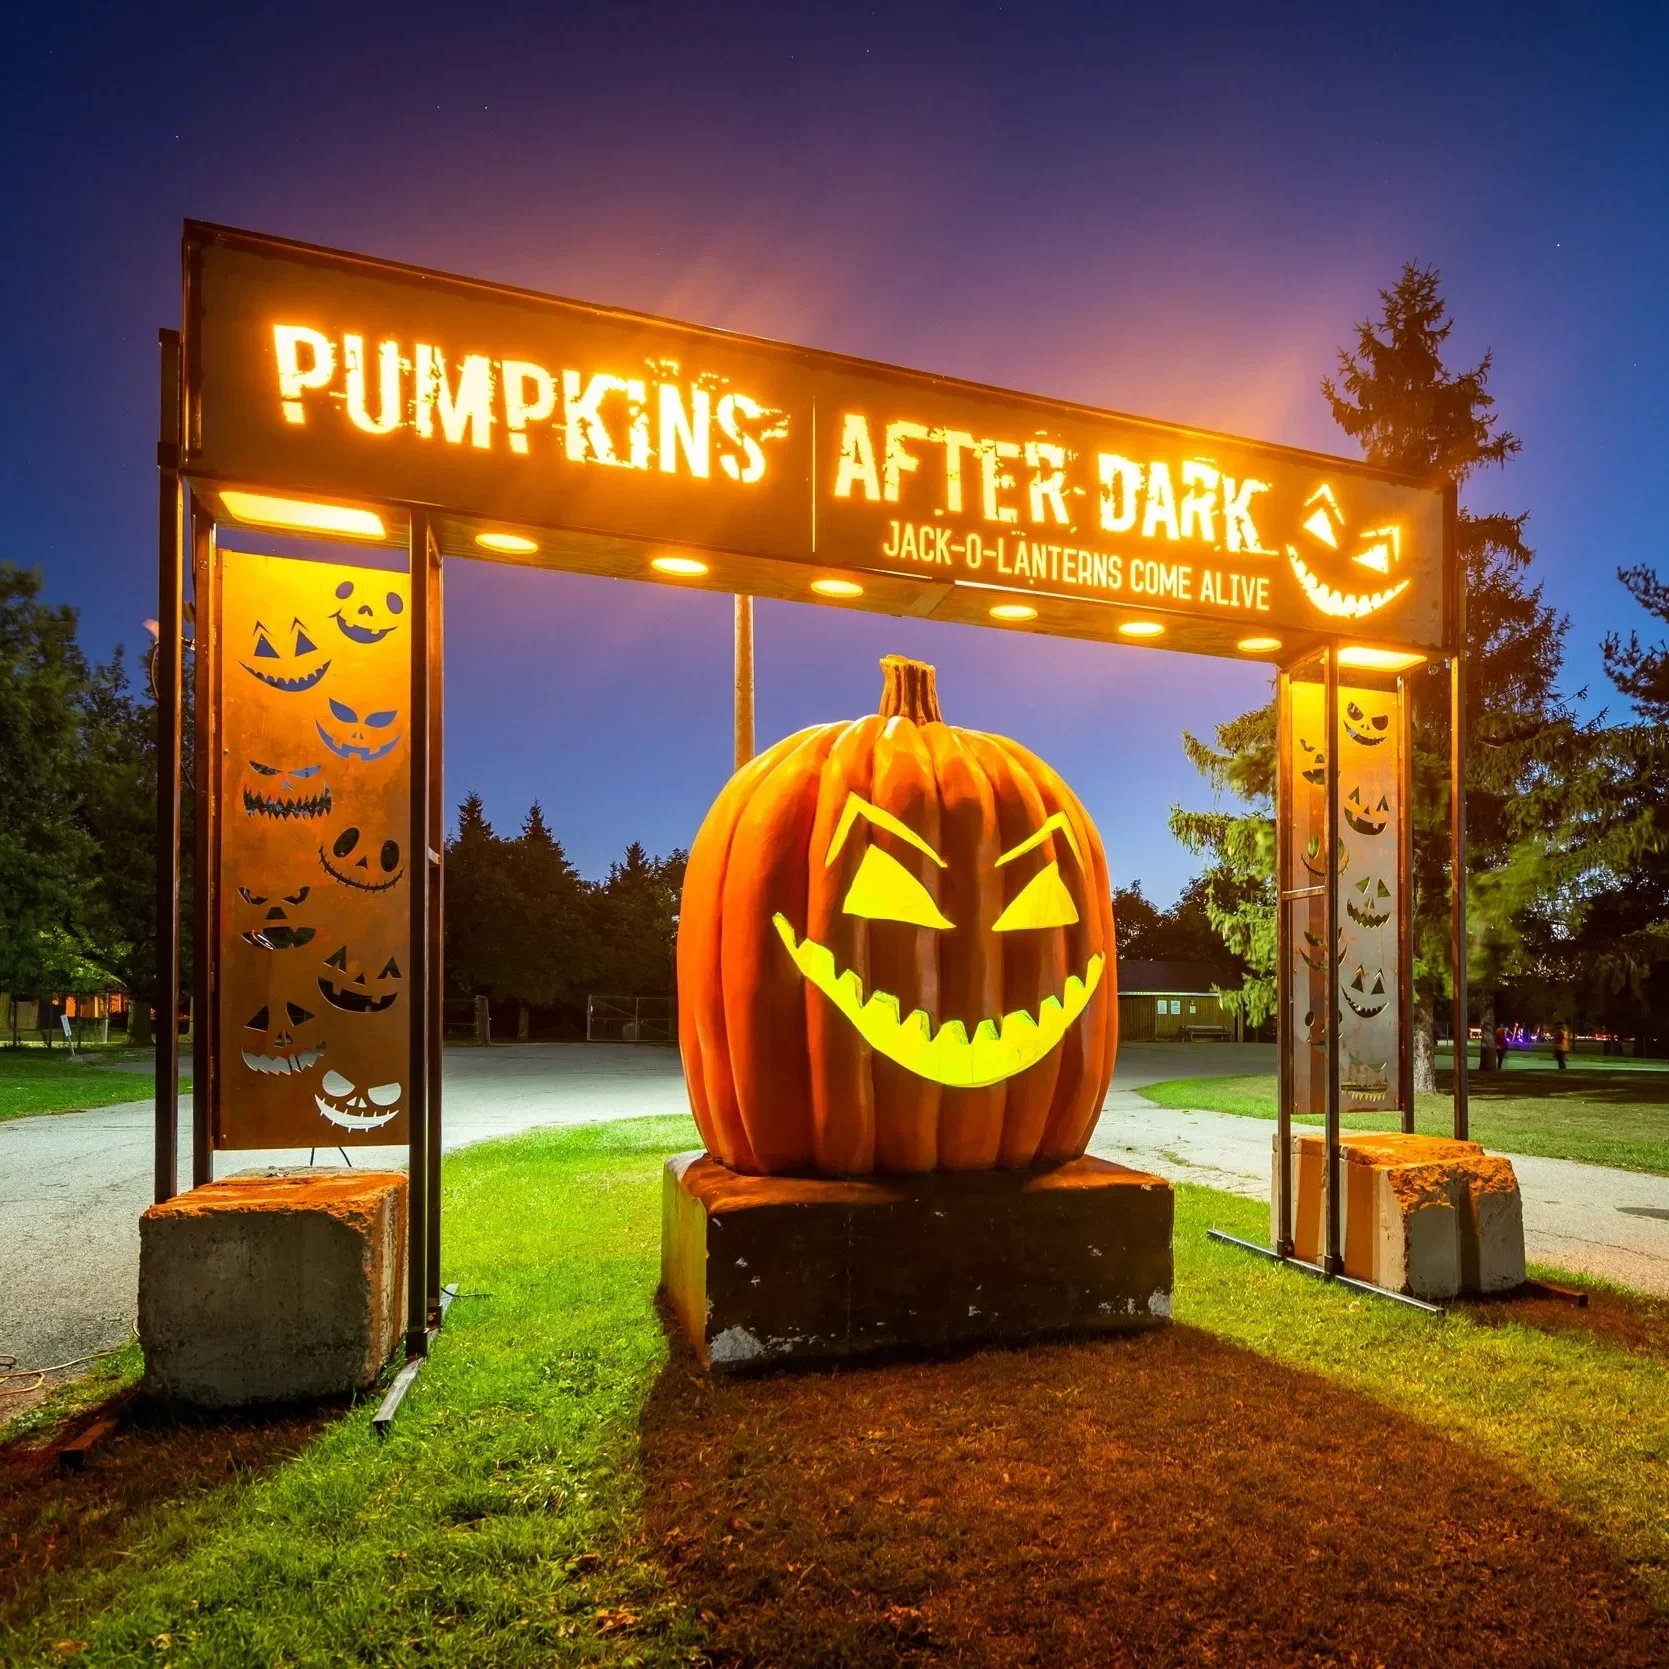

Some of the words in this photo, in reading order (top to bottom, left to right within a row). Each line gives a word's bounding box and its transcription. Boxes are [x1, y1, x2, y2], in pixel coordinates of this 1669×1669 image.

[272, 323, 784, 484] PUMPKINS
[834, 412, 1078, 526] AFTER
[1098, 452, 1279, 556] DARK
[883, 520, 1123, 589] JACK-O-LANTERNS
[1130, 562, 1193, 602] COME
[1199, 568, 1271, 613] ALIVE
